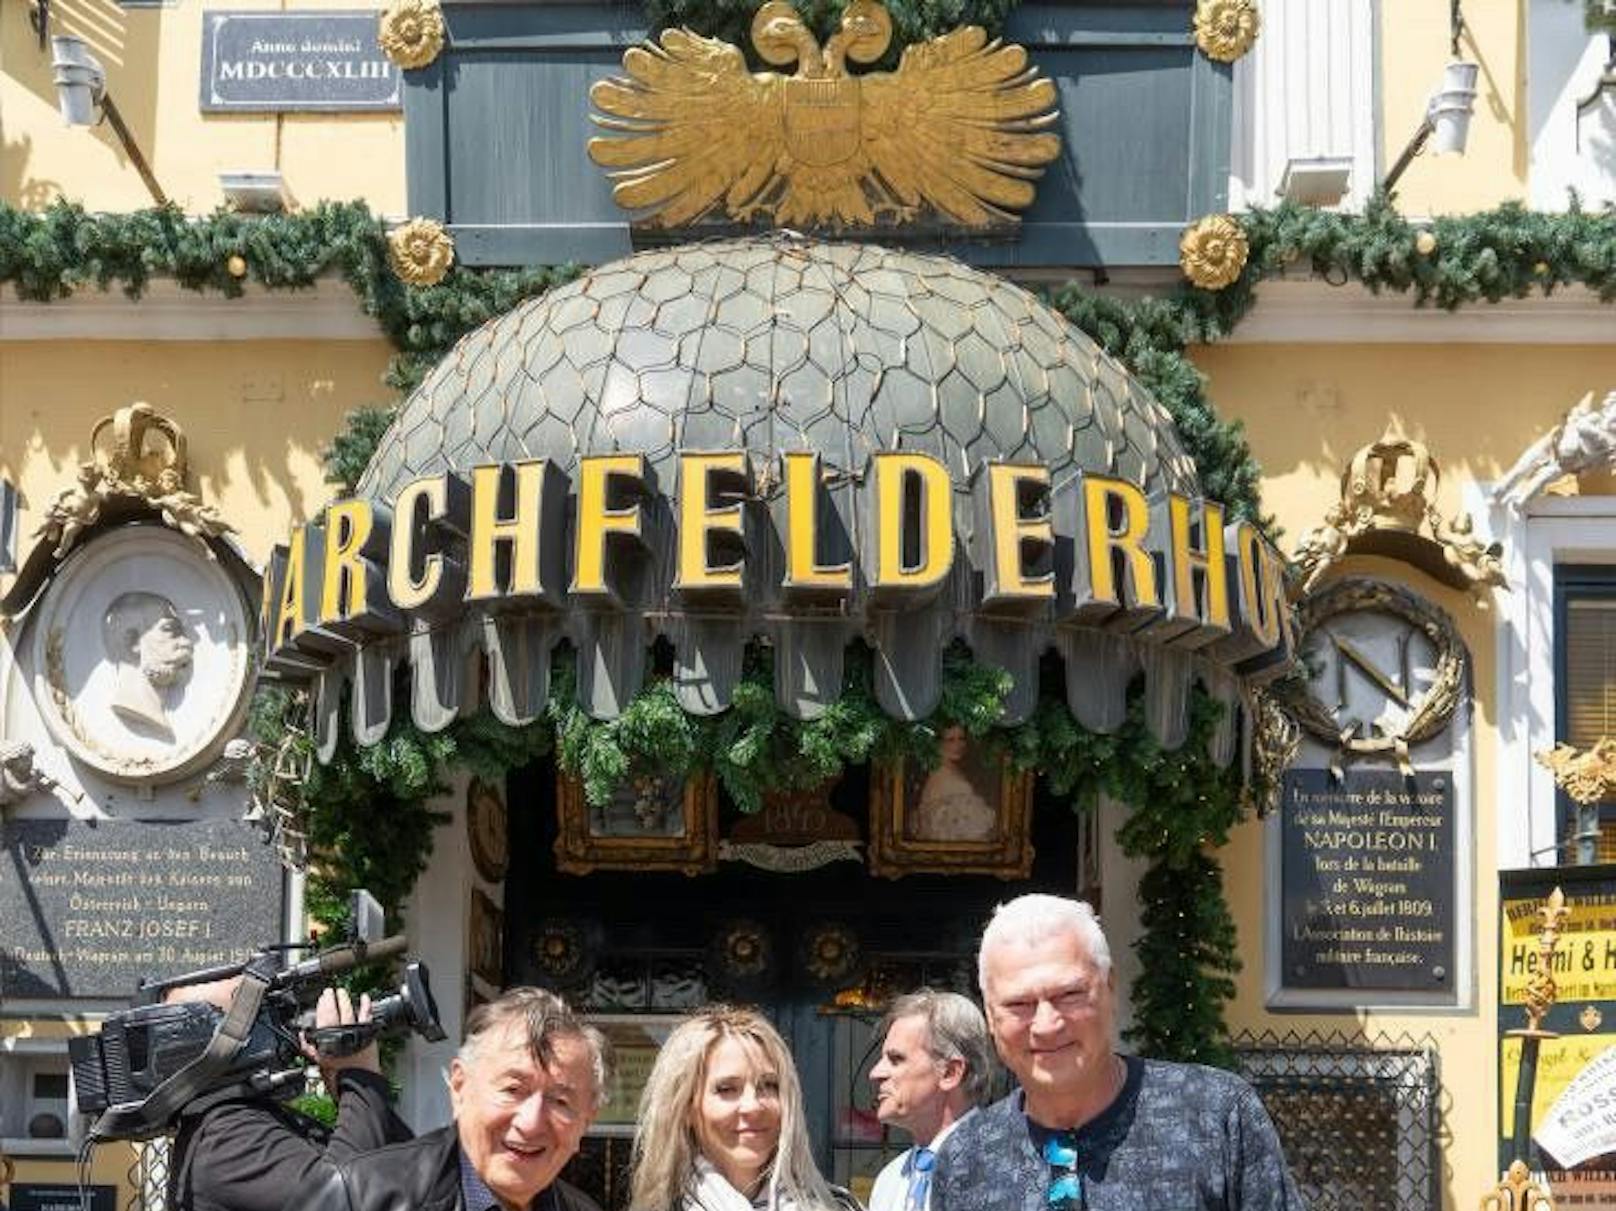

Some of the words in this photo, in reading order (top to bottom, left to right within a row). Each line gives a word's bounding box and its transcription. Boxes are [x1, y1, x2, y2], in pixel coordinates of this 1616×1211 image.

[64, 920, 133, 938] FRANZ
[137, 920, 200, 938] JOSEF
[1510, 941, 1573, 975] Hemi
